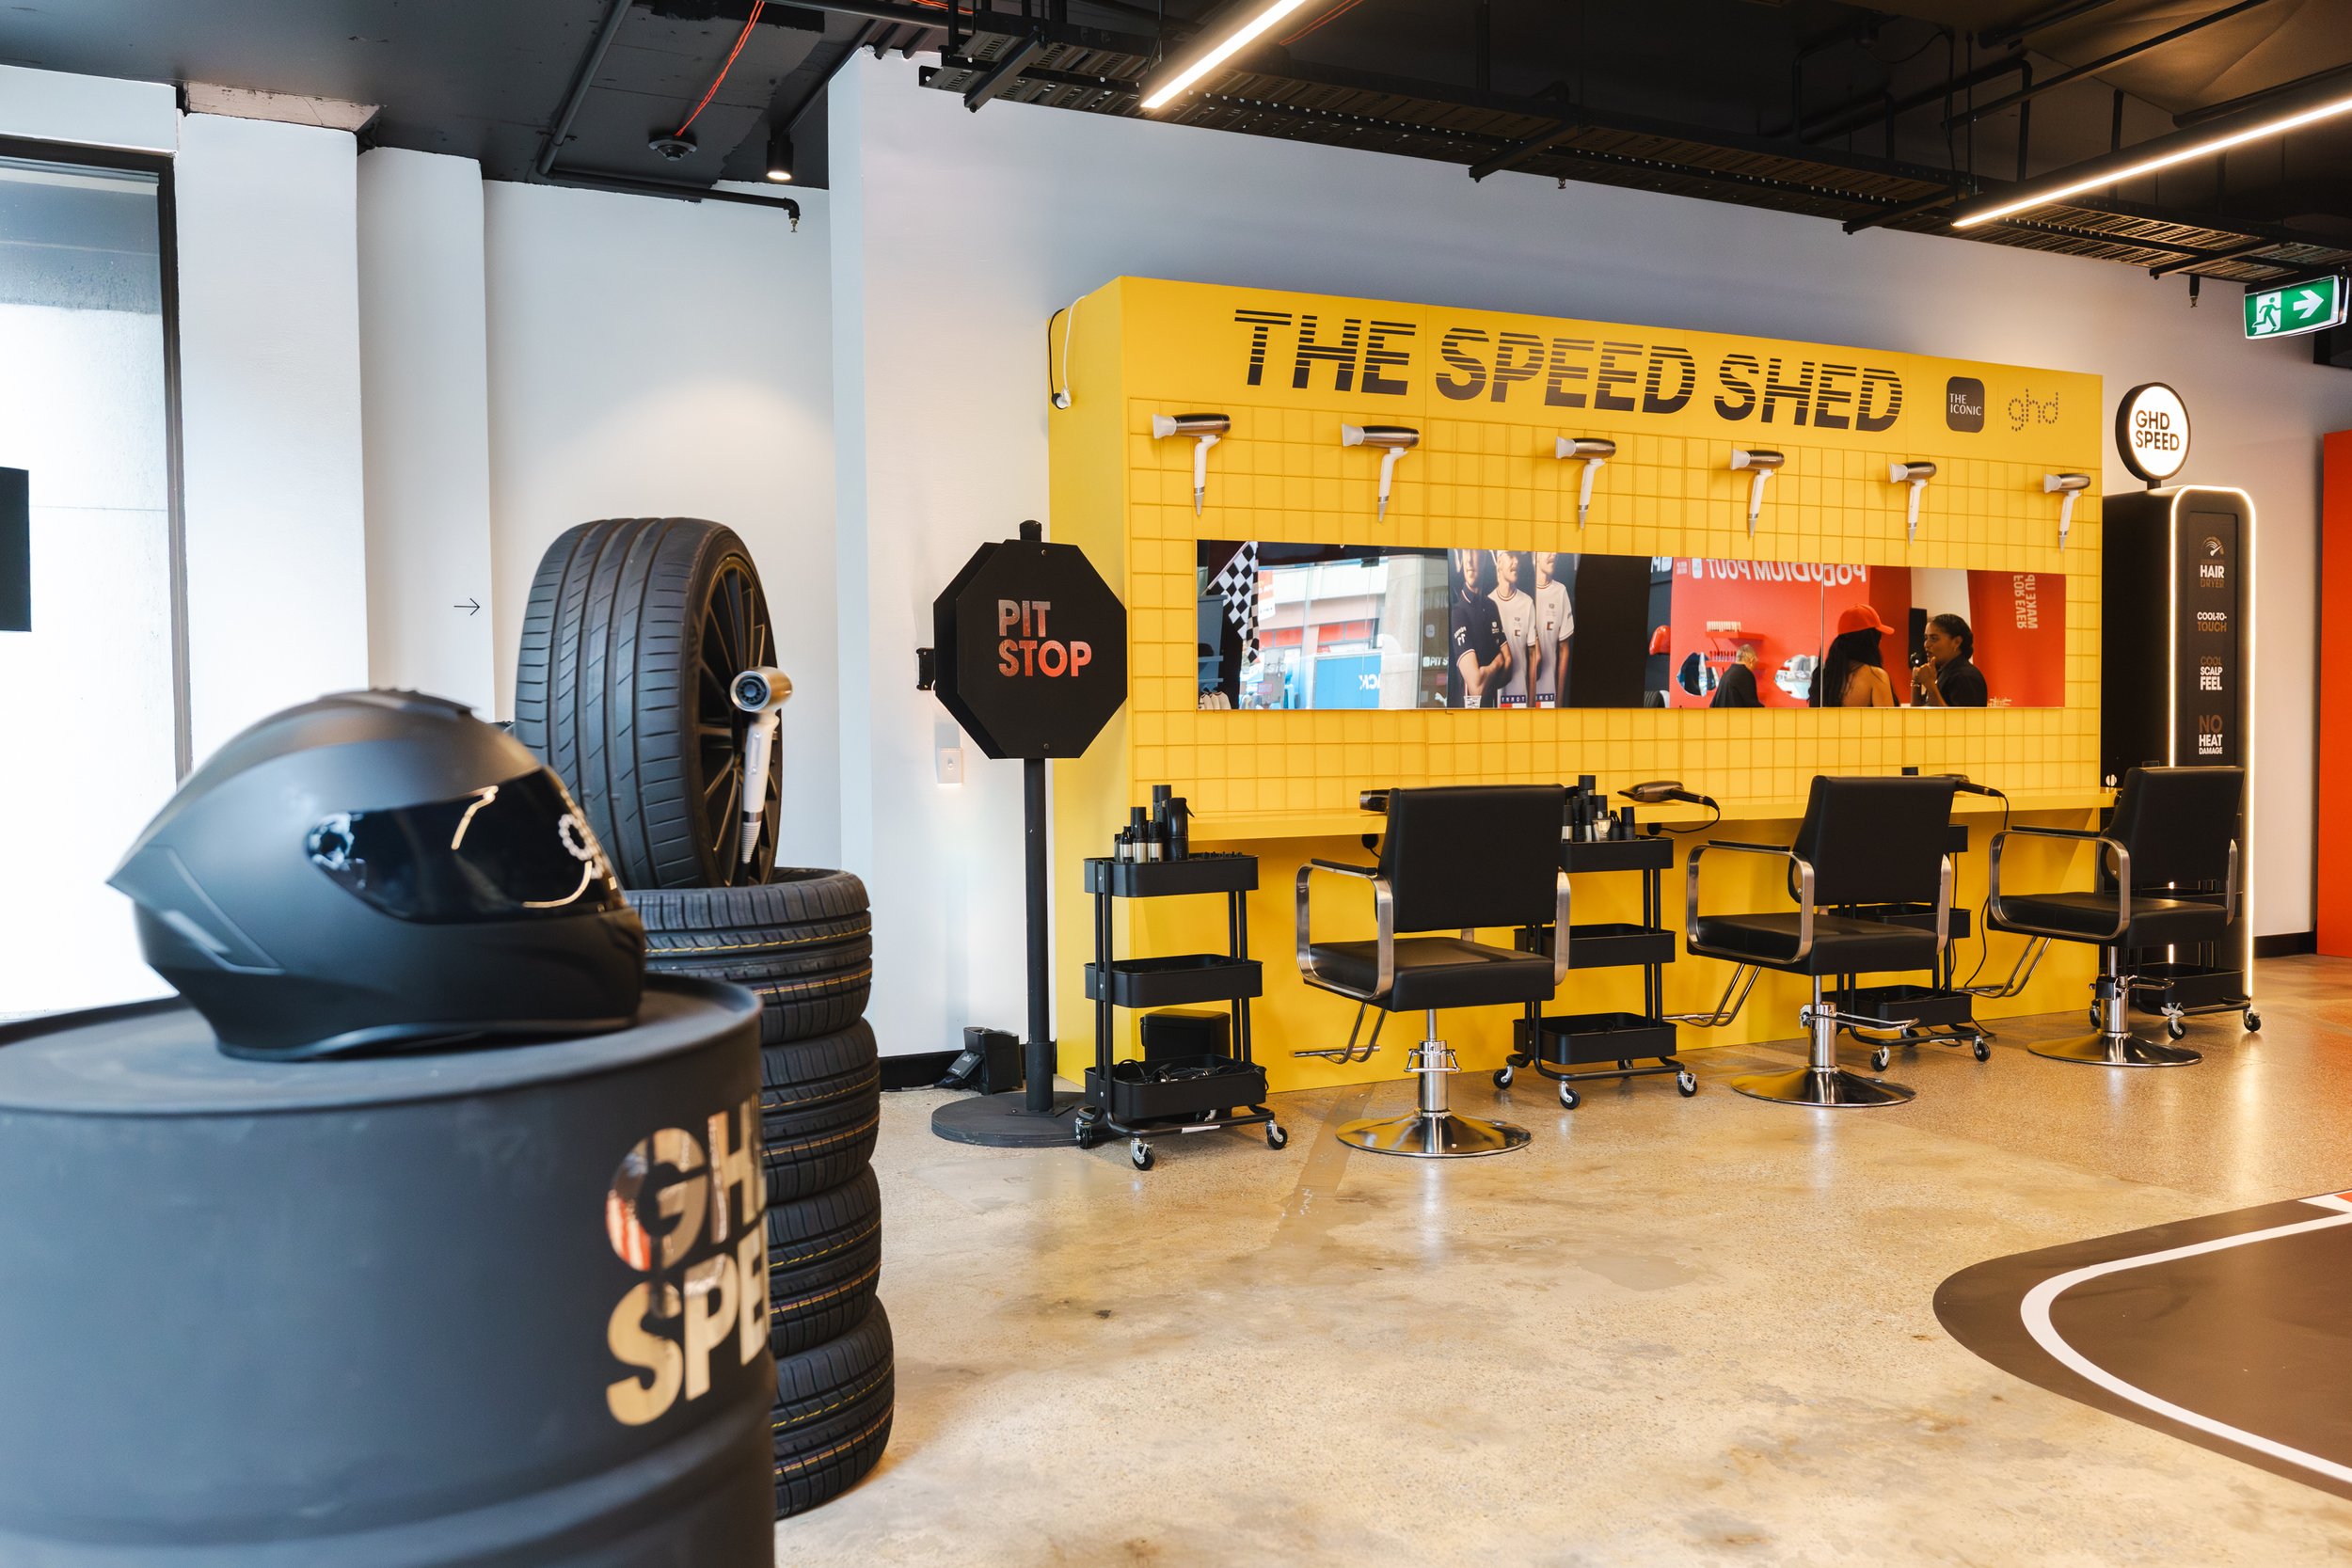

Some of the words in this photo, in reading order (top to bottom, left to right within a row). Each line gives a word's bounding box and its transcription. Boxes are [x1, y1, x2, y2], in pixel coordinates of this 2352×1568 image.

[1234, 309, 1416, 396] THE
[1436, 327, 1695, 414] SPEED
[1713, 354, 1902, 433] SHED
[1949, 393, 1967, 404] THE
[1949, 404, 1982, 416] ICONIC
[2008, 388, 2058, 432] ghd
[2136, 410, 2170, 430] GHD
[2136, 430, 2180, 451] SPEED
[2200, 564, 2225, 578] HAIR
[998, 599, 1051, 638] PIT
[2197, 621, 2227, 632] TOUCH
[998, 639, 1092, 677] STOP
[2200, 666, 2223, 675] SCALP
[2200, 676, 2223, 690] FEEL
[2199, 715, 2223, 734] NO
[2199, 734, 2223, 747] HEAT
[2199, 747, 2223, 755] DAMAGE
[606, 1093, 768, 1272] GH
[606, 1215, 771, 1426] SPE
